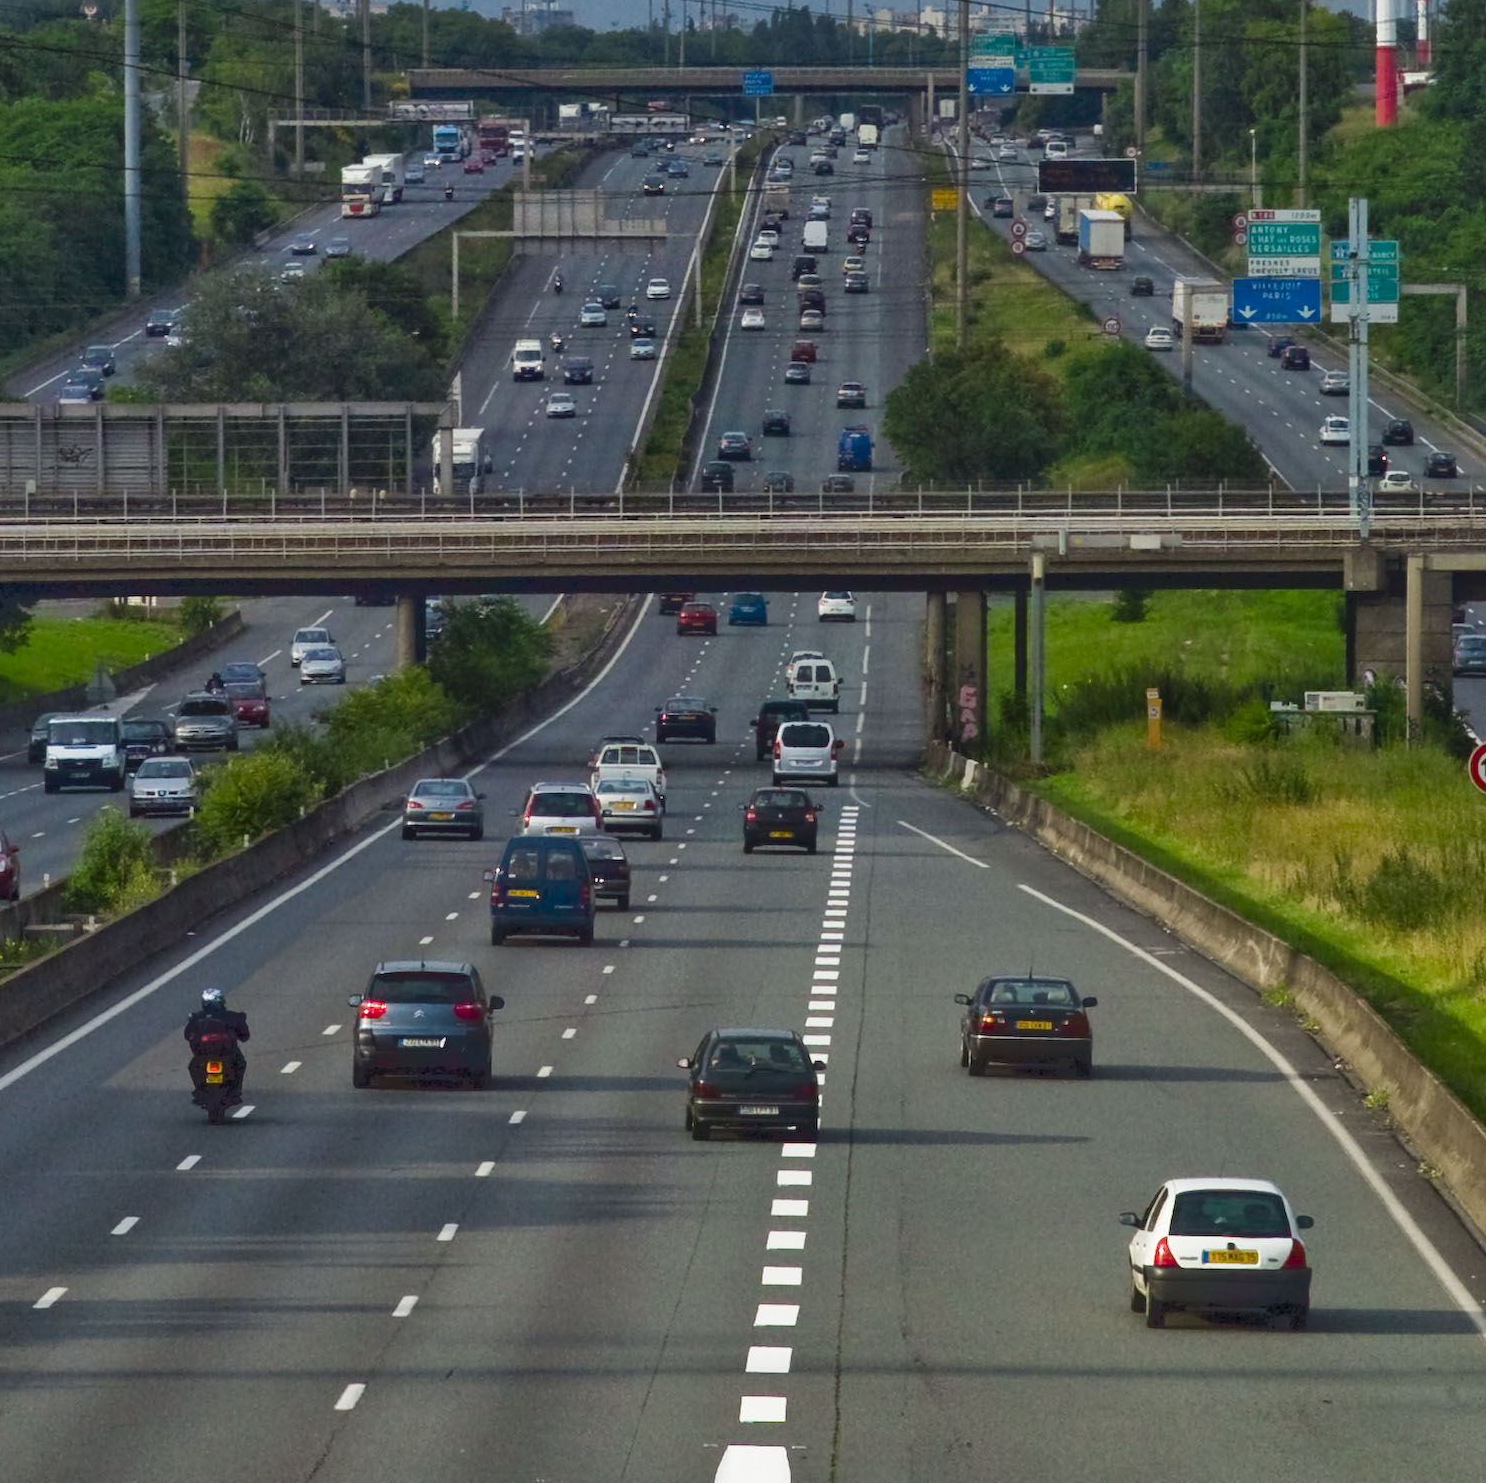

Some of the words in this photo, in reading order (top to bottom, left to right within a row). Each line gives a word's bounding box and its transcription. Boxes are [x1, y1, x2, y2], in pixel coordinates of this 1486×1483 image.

[1251, 226, 1289, 234] ANTONY
[1251, 245, 1310, 253] VERSAILLES
[1262, 292, 1291, 300] PARIS
